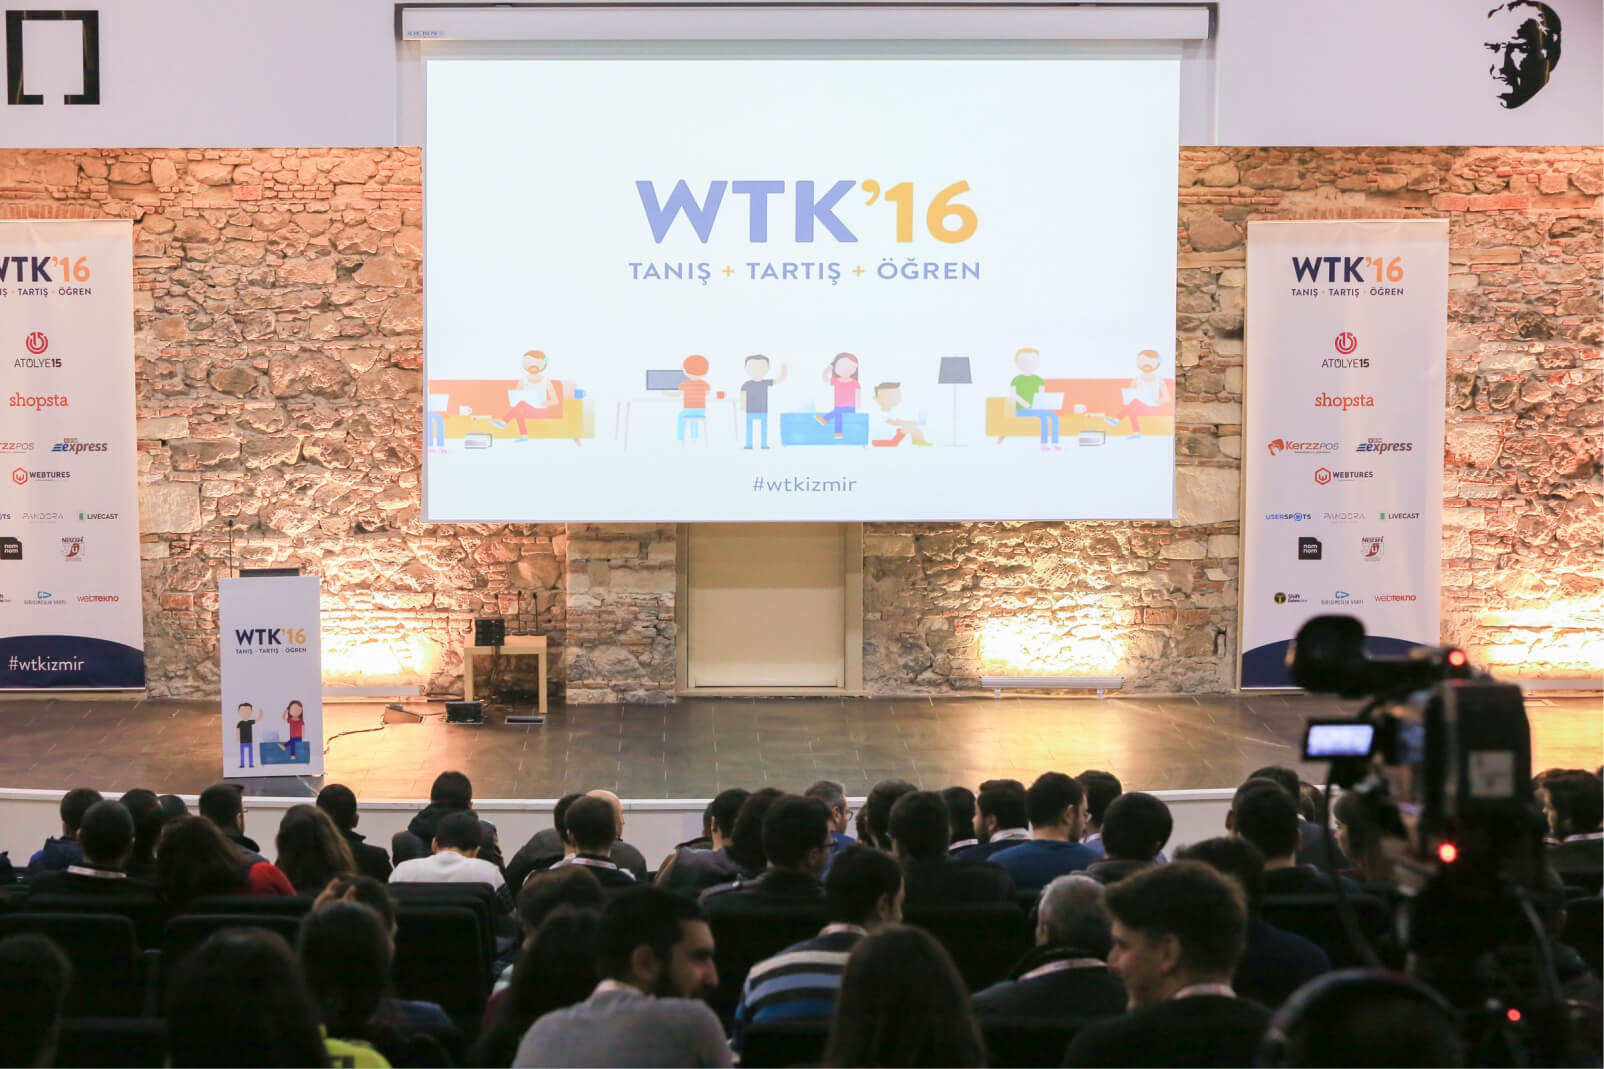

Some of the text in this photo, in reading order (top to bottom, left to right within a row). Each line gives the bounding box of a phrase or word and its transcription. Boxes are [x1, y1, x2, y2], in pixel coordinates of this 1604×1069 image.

[635, 179, 978, 244] WTK'16
[628, 262, 711, 285] TANIŞ
[746, 262, 840, 285] TARTIŞ
[877, 258, 979, 279] ÖĞREN
[1292, 256, 1404, 283] WTK'16
[18, 288, 48, 298] TARTIŞ
[1291, 289, 1318, 298] TANIŞ
[1328, 289, 1359, 298] TARTIŞ
[9, 392, 68, 411] shopsta
[1315, 392, 1374, 411] shopsta
[62, 441, 108, 455] express
[1365, 441, 1413, 455] express
[752, 477, 856, 492] #wtkizmir
[235, 628, 307, 645] WTK'16
[8, 656, 85, 671] #wtkizmir
